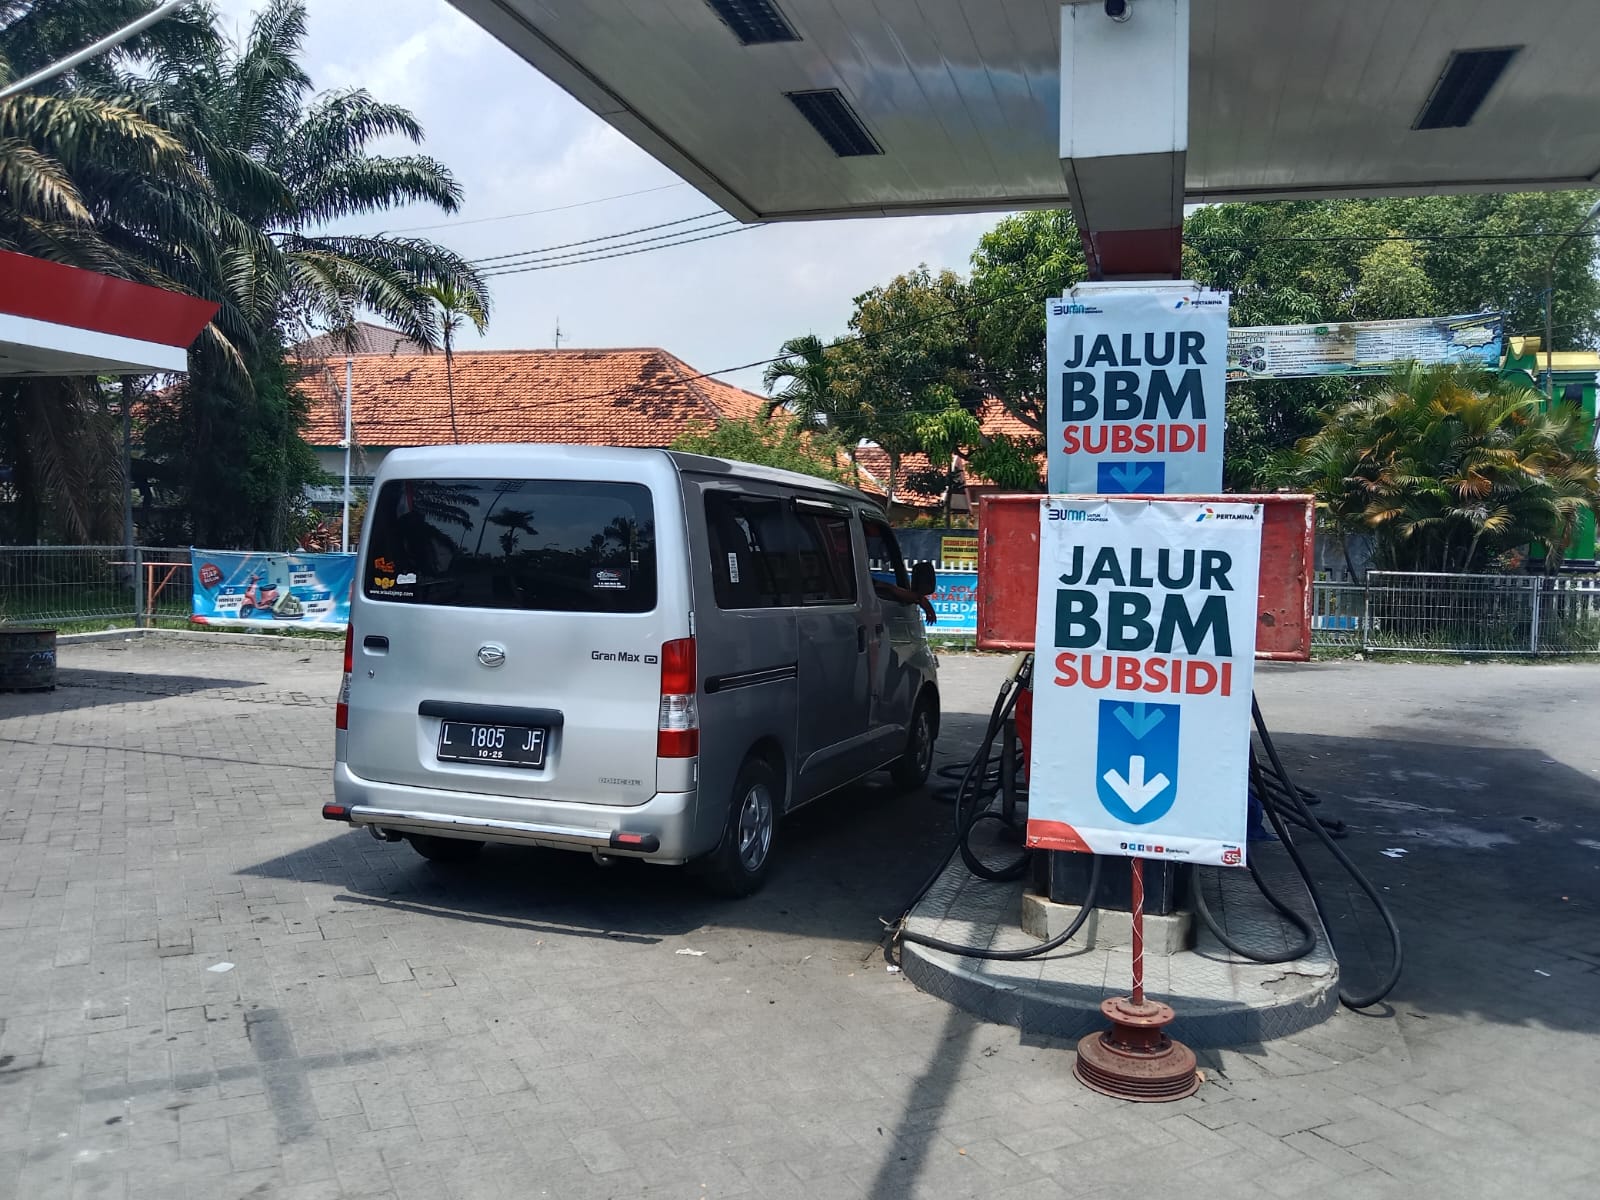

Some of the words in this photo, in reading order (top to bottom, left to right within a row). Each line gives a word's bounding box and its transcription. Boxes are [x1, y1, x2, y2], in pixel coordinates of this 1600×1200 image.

[1064, 331, 1208, 369] JALUR
[1062, 368, 1206, 422] BBM
[1062, 423, 1206, 455] SUBSIDI
[1215, 513, 1254, 521] PERTAMINA
[1058, 545, 1234, 591] JALUR
[1054, 588, 1233, 657] BBM
[591, 650, 616, 661] Gran
[617, 651, 640, 662] Max
[1054, 652, 1232, 697] SUBSIDI
[443, 724, 452, 745] L
[471, 726, 506, 749] 1805
[521, 730, 541, 751] JF
